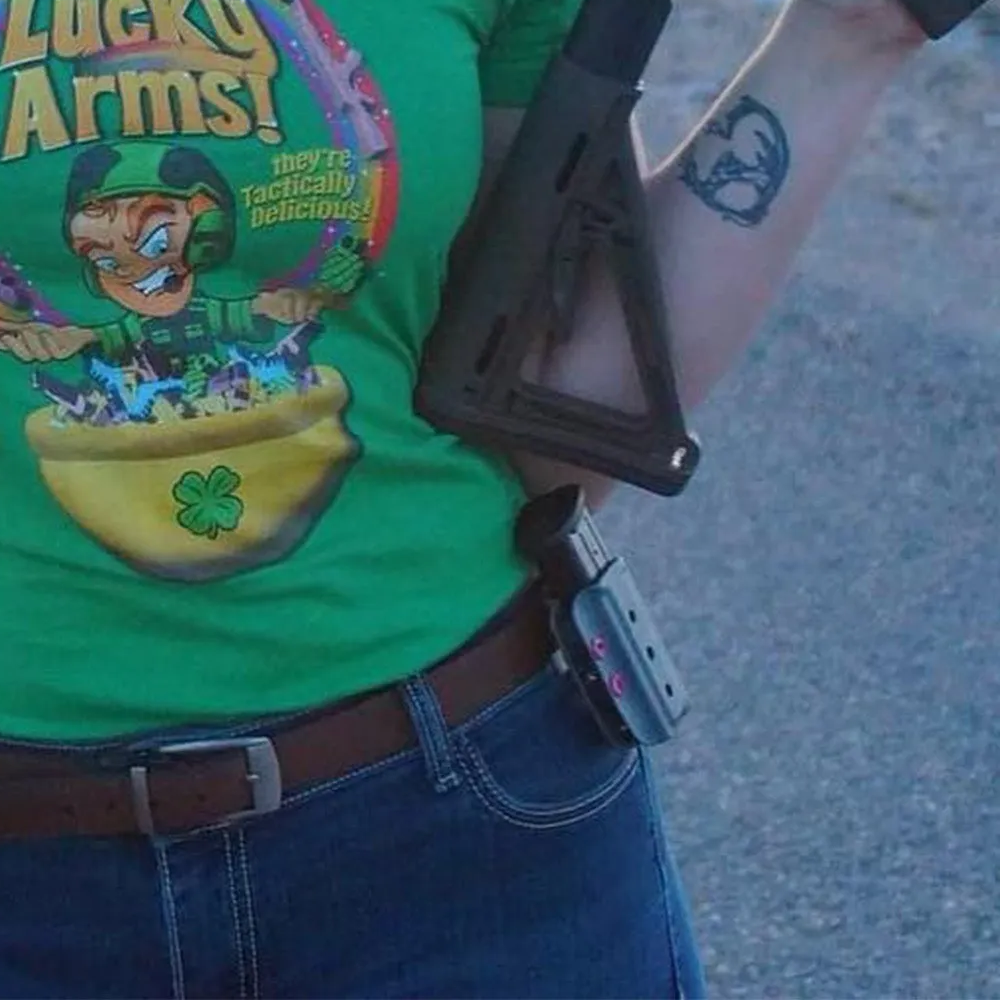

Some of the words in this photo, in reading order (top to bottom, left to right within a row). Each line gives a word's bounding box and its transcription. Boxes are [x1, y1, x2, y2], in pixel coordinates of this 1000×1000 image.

[0, 62, 286, 163] Arms!
[271, 147, 353, 177] they're
[240, 170, 357, 209] Tactically
[250, 196, 374, 230] Delicious!
